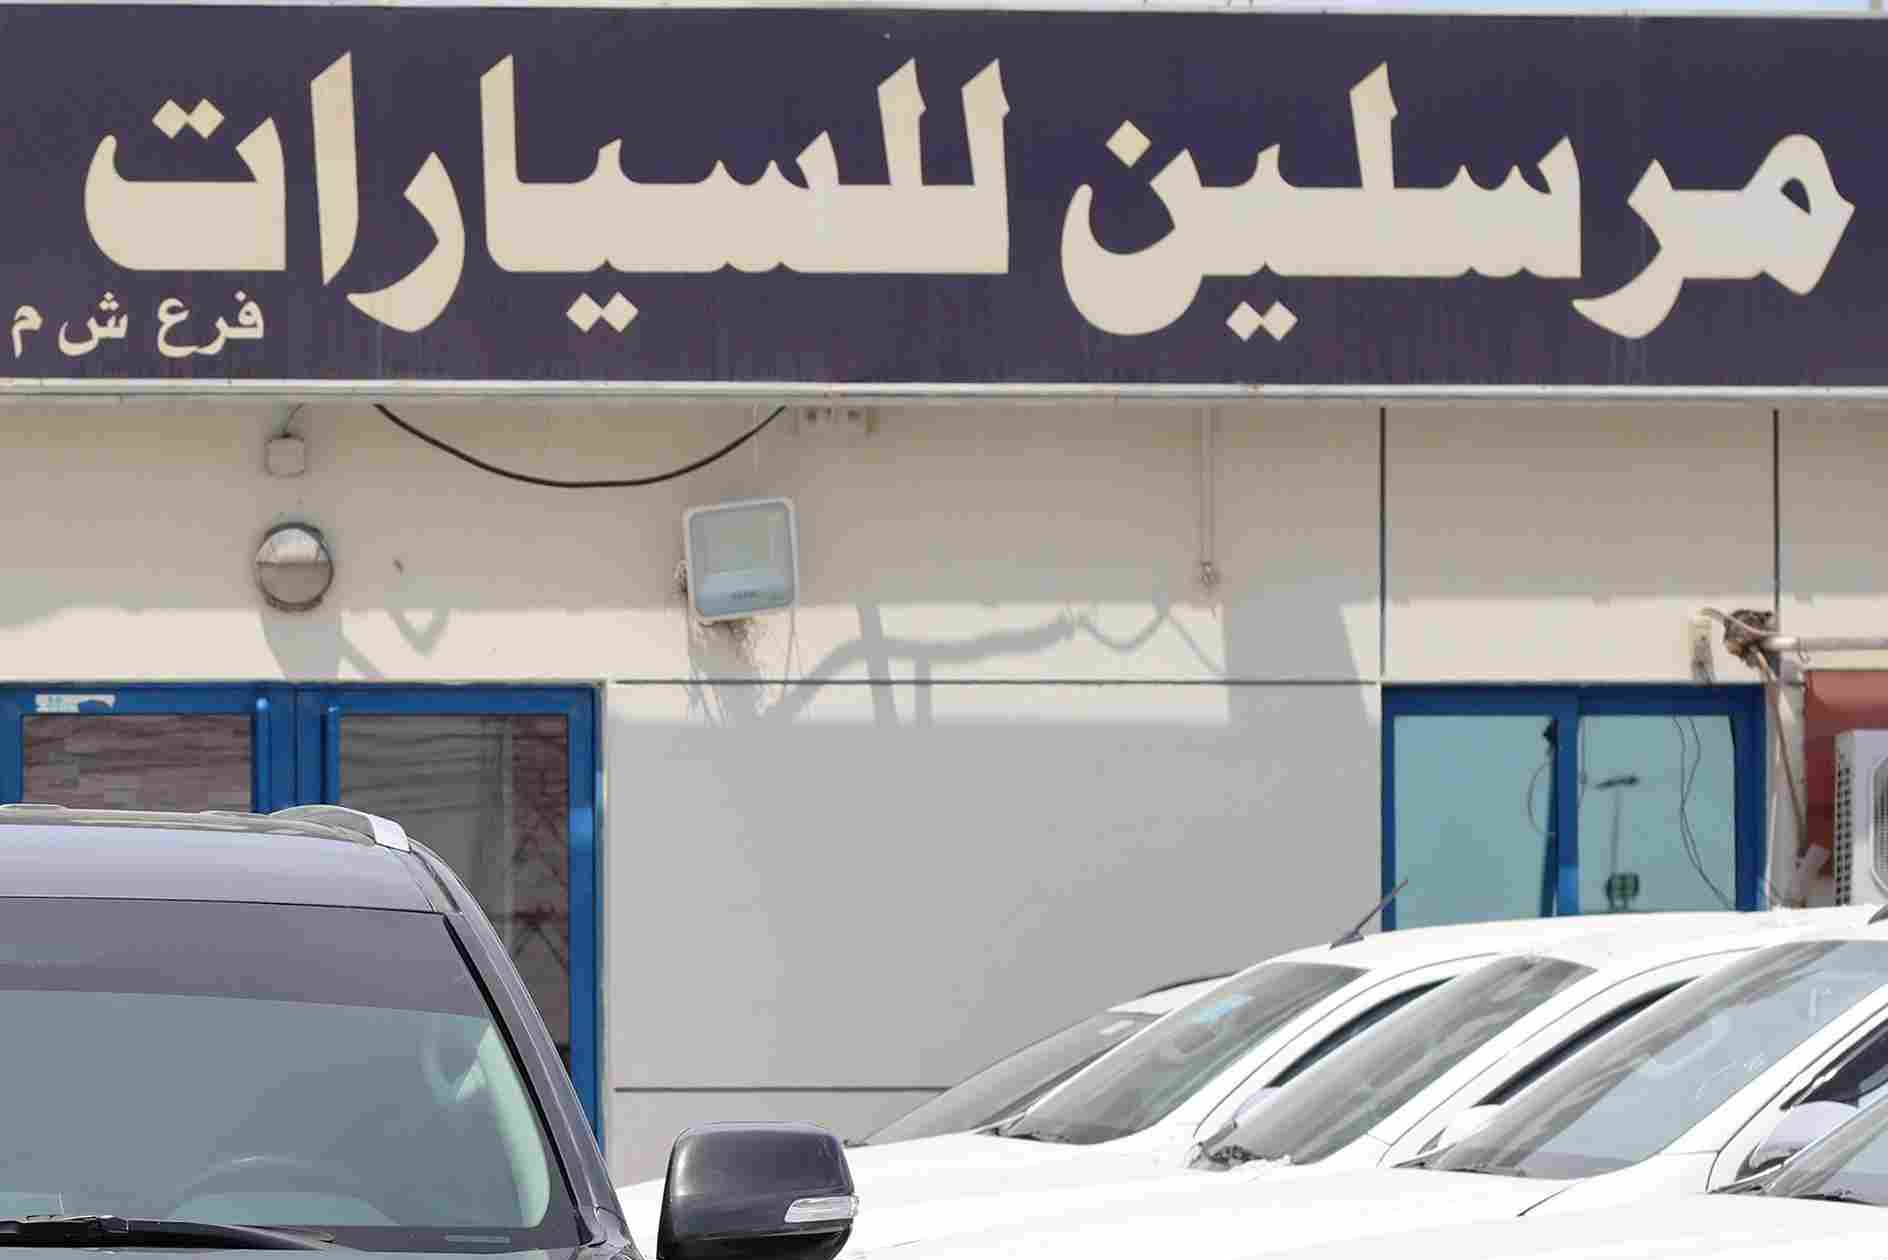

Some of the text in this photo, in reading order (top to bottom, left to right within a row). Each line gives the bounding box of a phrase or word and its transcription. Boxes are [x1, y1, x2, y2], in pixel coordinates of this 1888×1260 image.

[84, 51, 1855, 340] مرسلين للسيارات
[11, 305, 43, 358] م
[58, 291, 129, 357] ش
[157, 290, 264, 358] فرع
